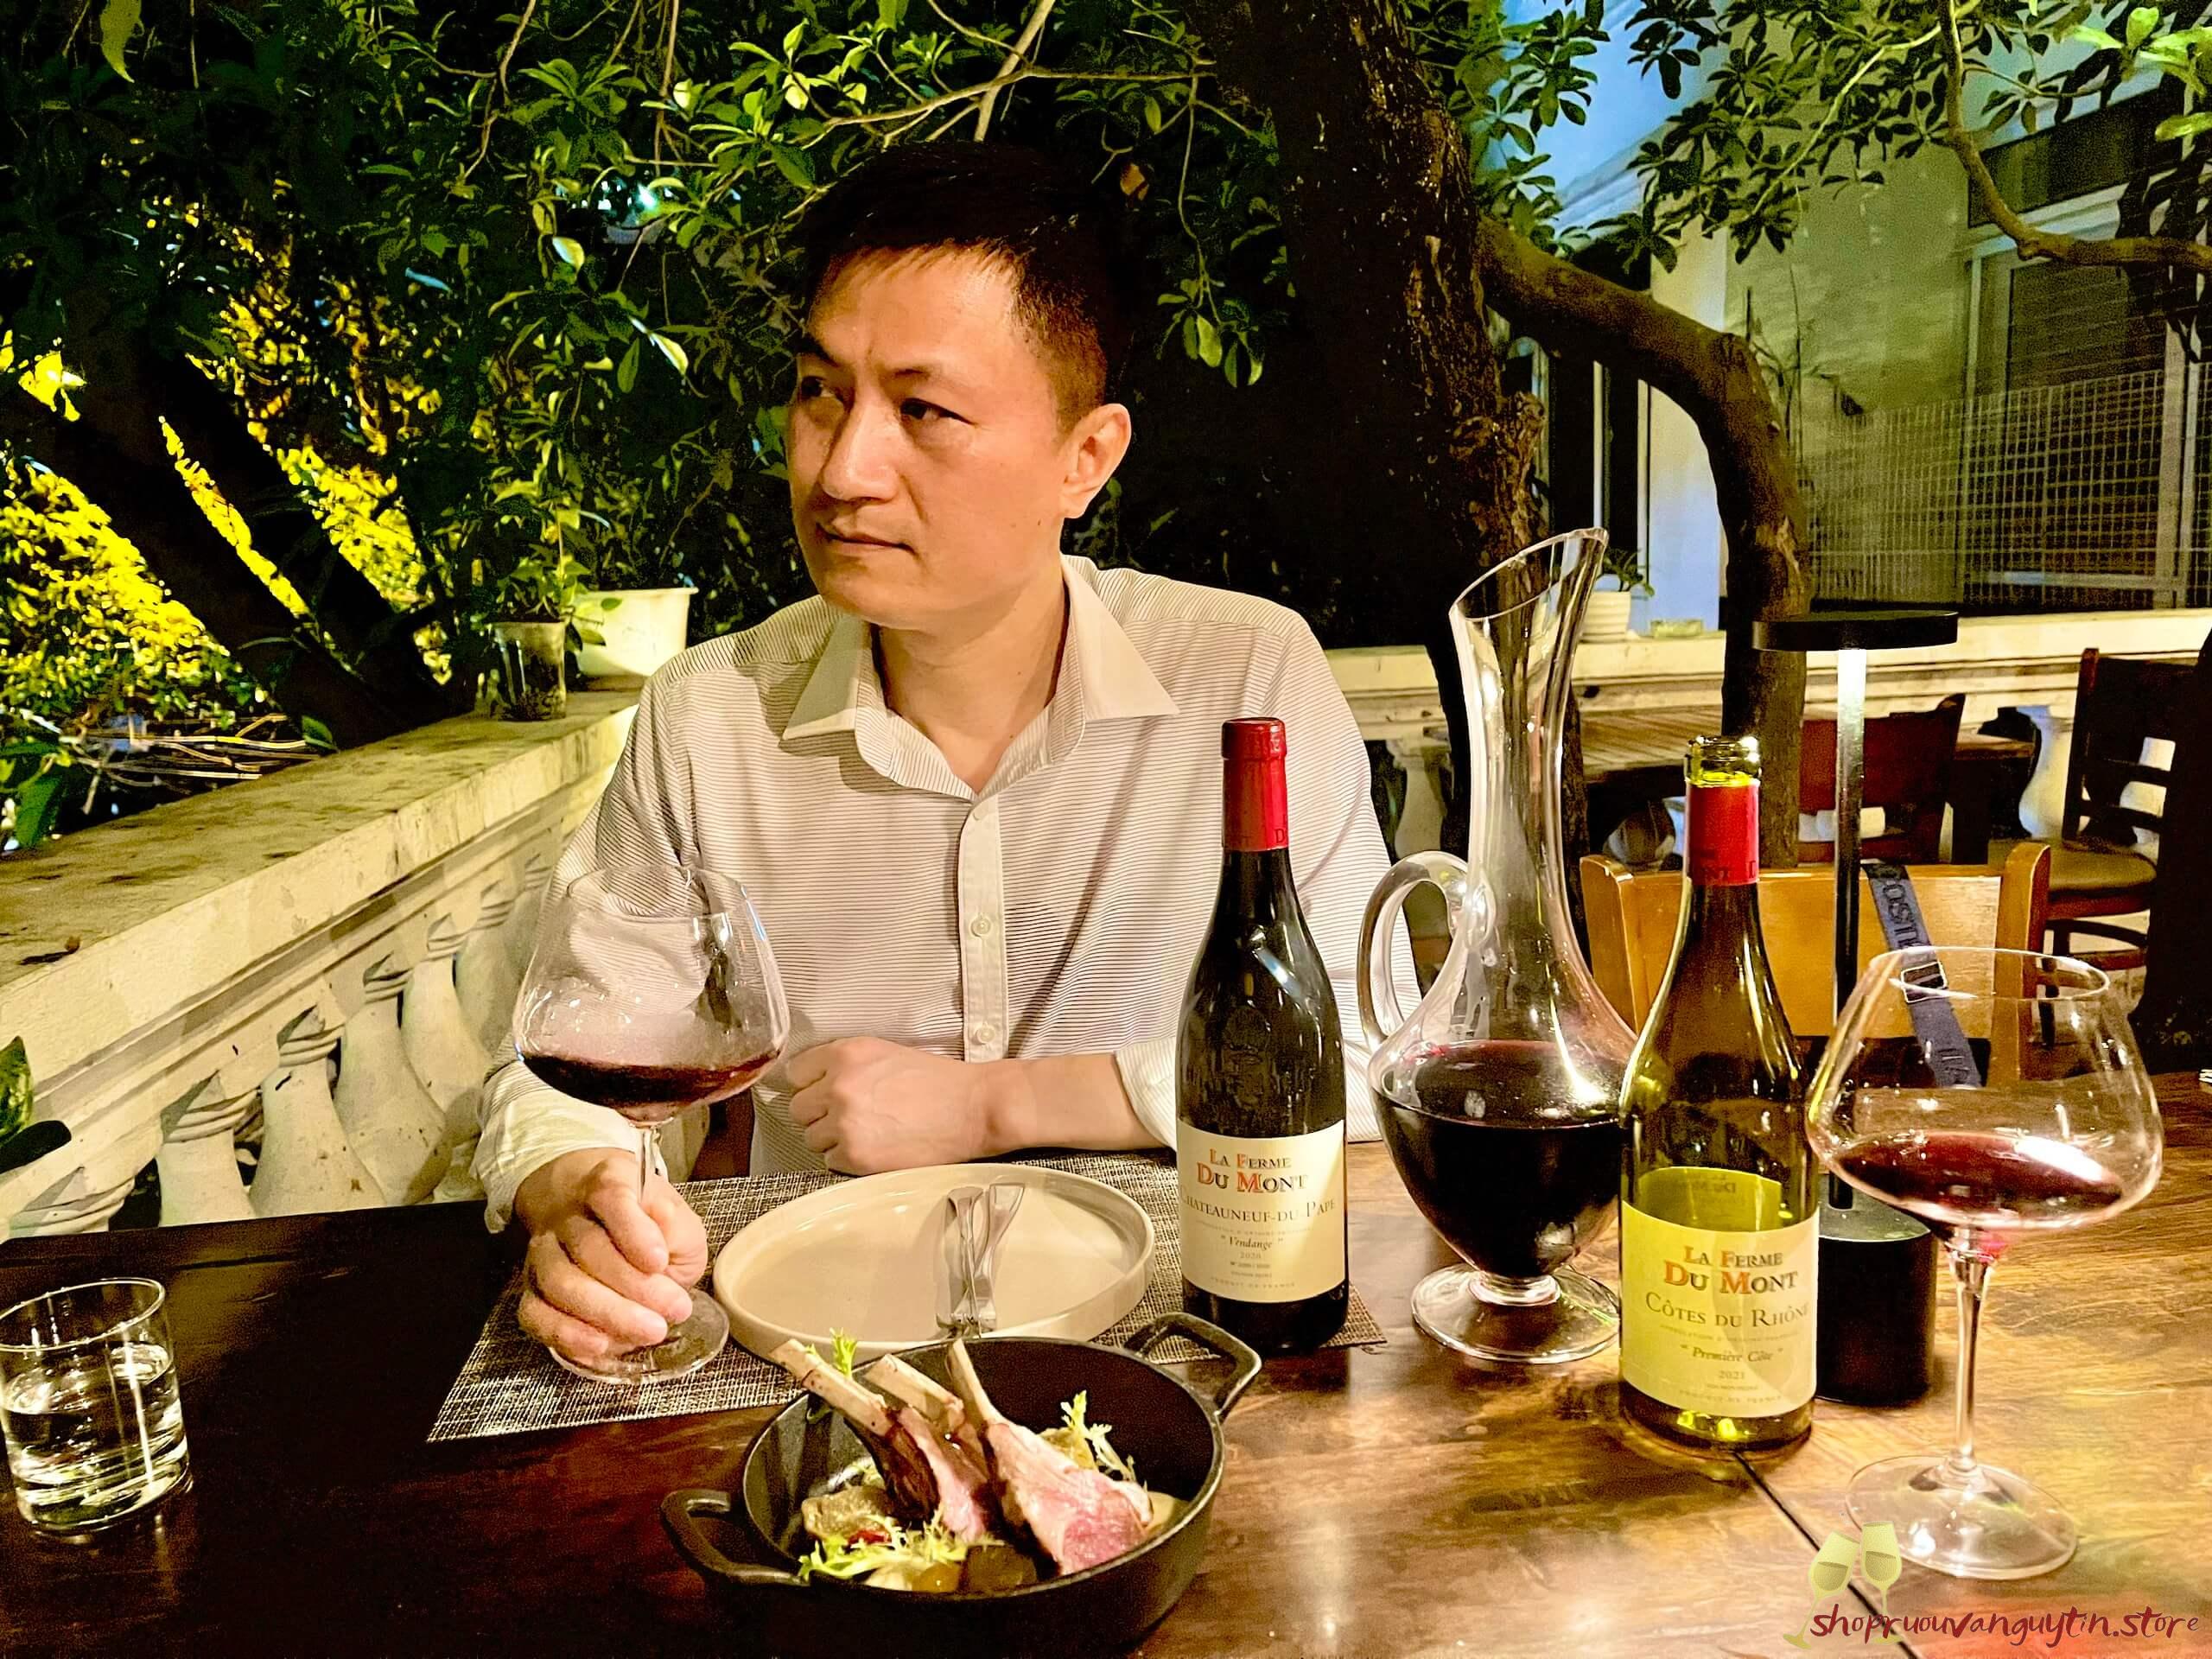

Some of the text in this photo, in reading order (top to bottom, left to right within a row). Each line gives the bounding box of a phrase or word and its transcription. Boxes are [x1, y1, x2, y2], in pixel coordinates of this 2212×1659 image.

[1210, 1147, 1292, 1169] LA FERME
[1197, 1161, 1309, 1194] DU MONT
[1684, 1245, 1783, 1268] LA FERME
[1663, 1261, 1798, 1294] DU MONT
[1645, 1291, 1707, 1325] CÔTES
[1714, 1313, 1744, 1329] DU
